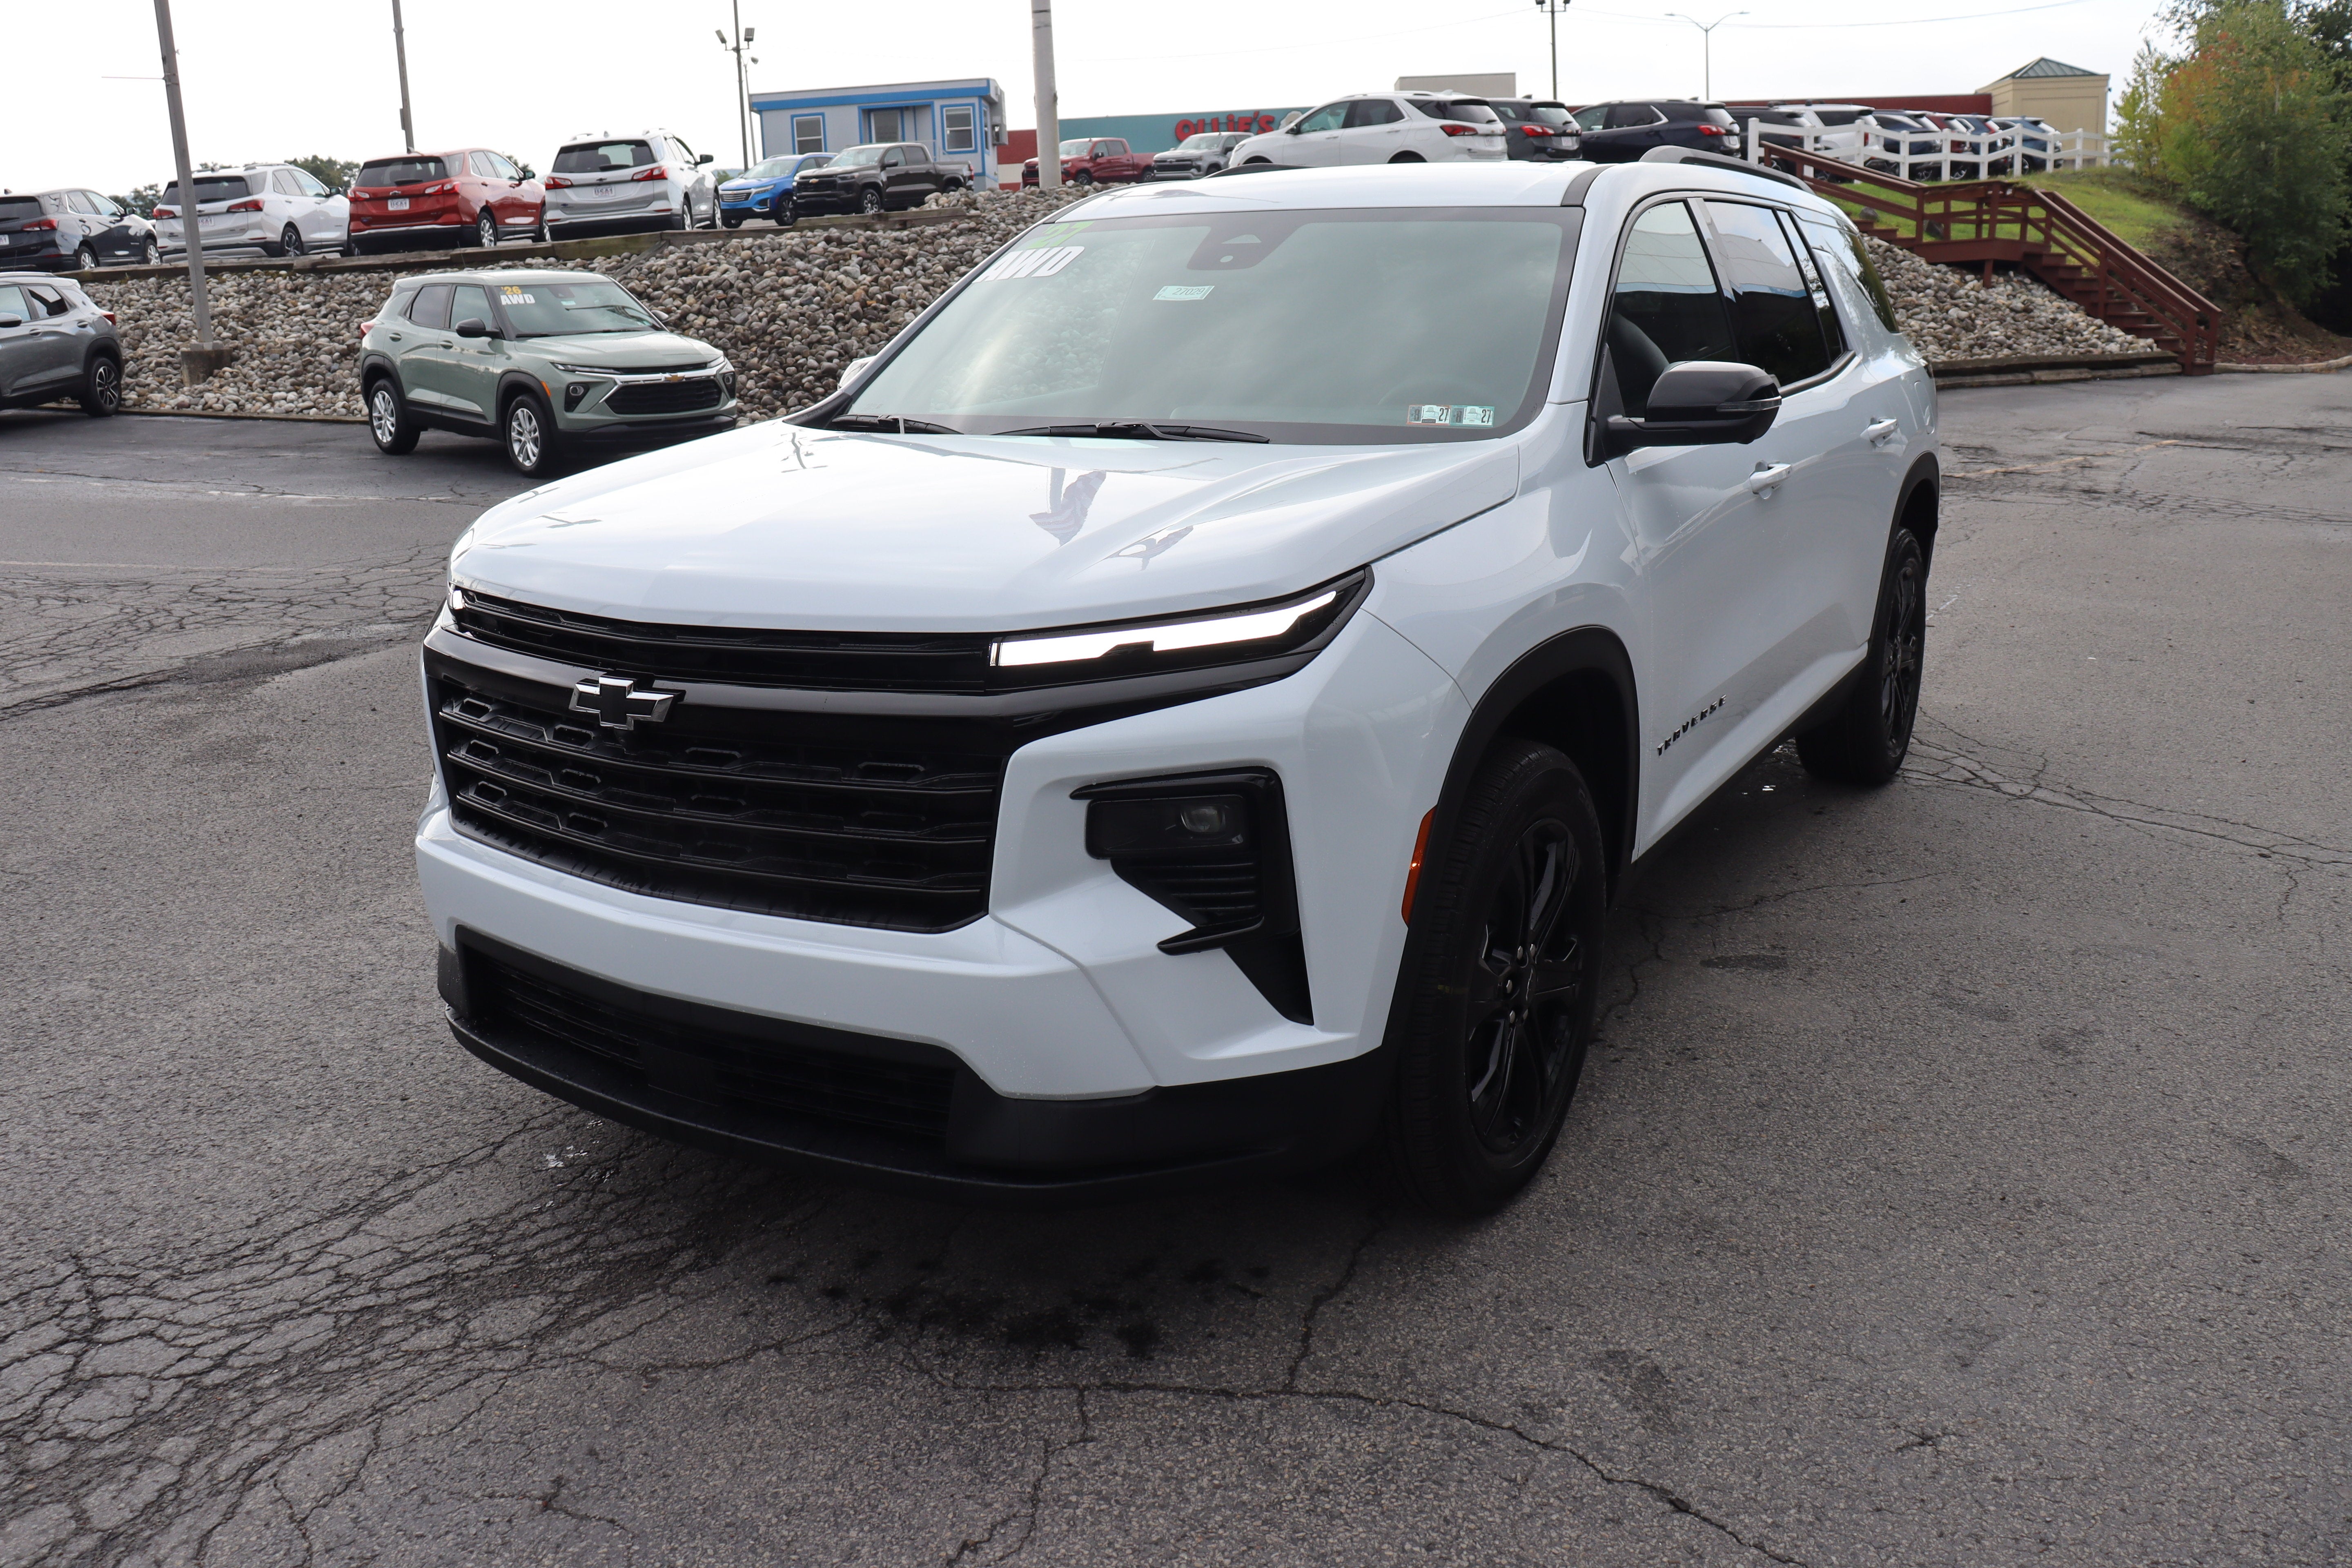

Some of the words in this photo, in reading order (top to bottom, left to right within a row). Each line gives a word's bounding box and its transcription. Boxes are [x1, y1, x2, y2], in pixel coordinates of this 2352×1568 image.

[972, 246, 1085, 283] AWD
[501, 286, 522, 294] '26
[1172, 287, 1206, 296] 27029
[500, 294, 536, 305] AWD
[1439, 408, 1449, 422] 27
[1481, 409, 1491, 423] 27
[1657, 694, 1727, 757] TRAVERSE
